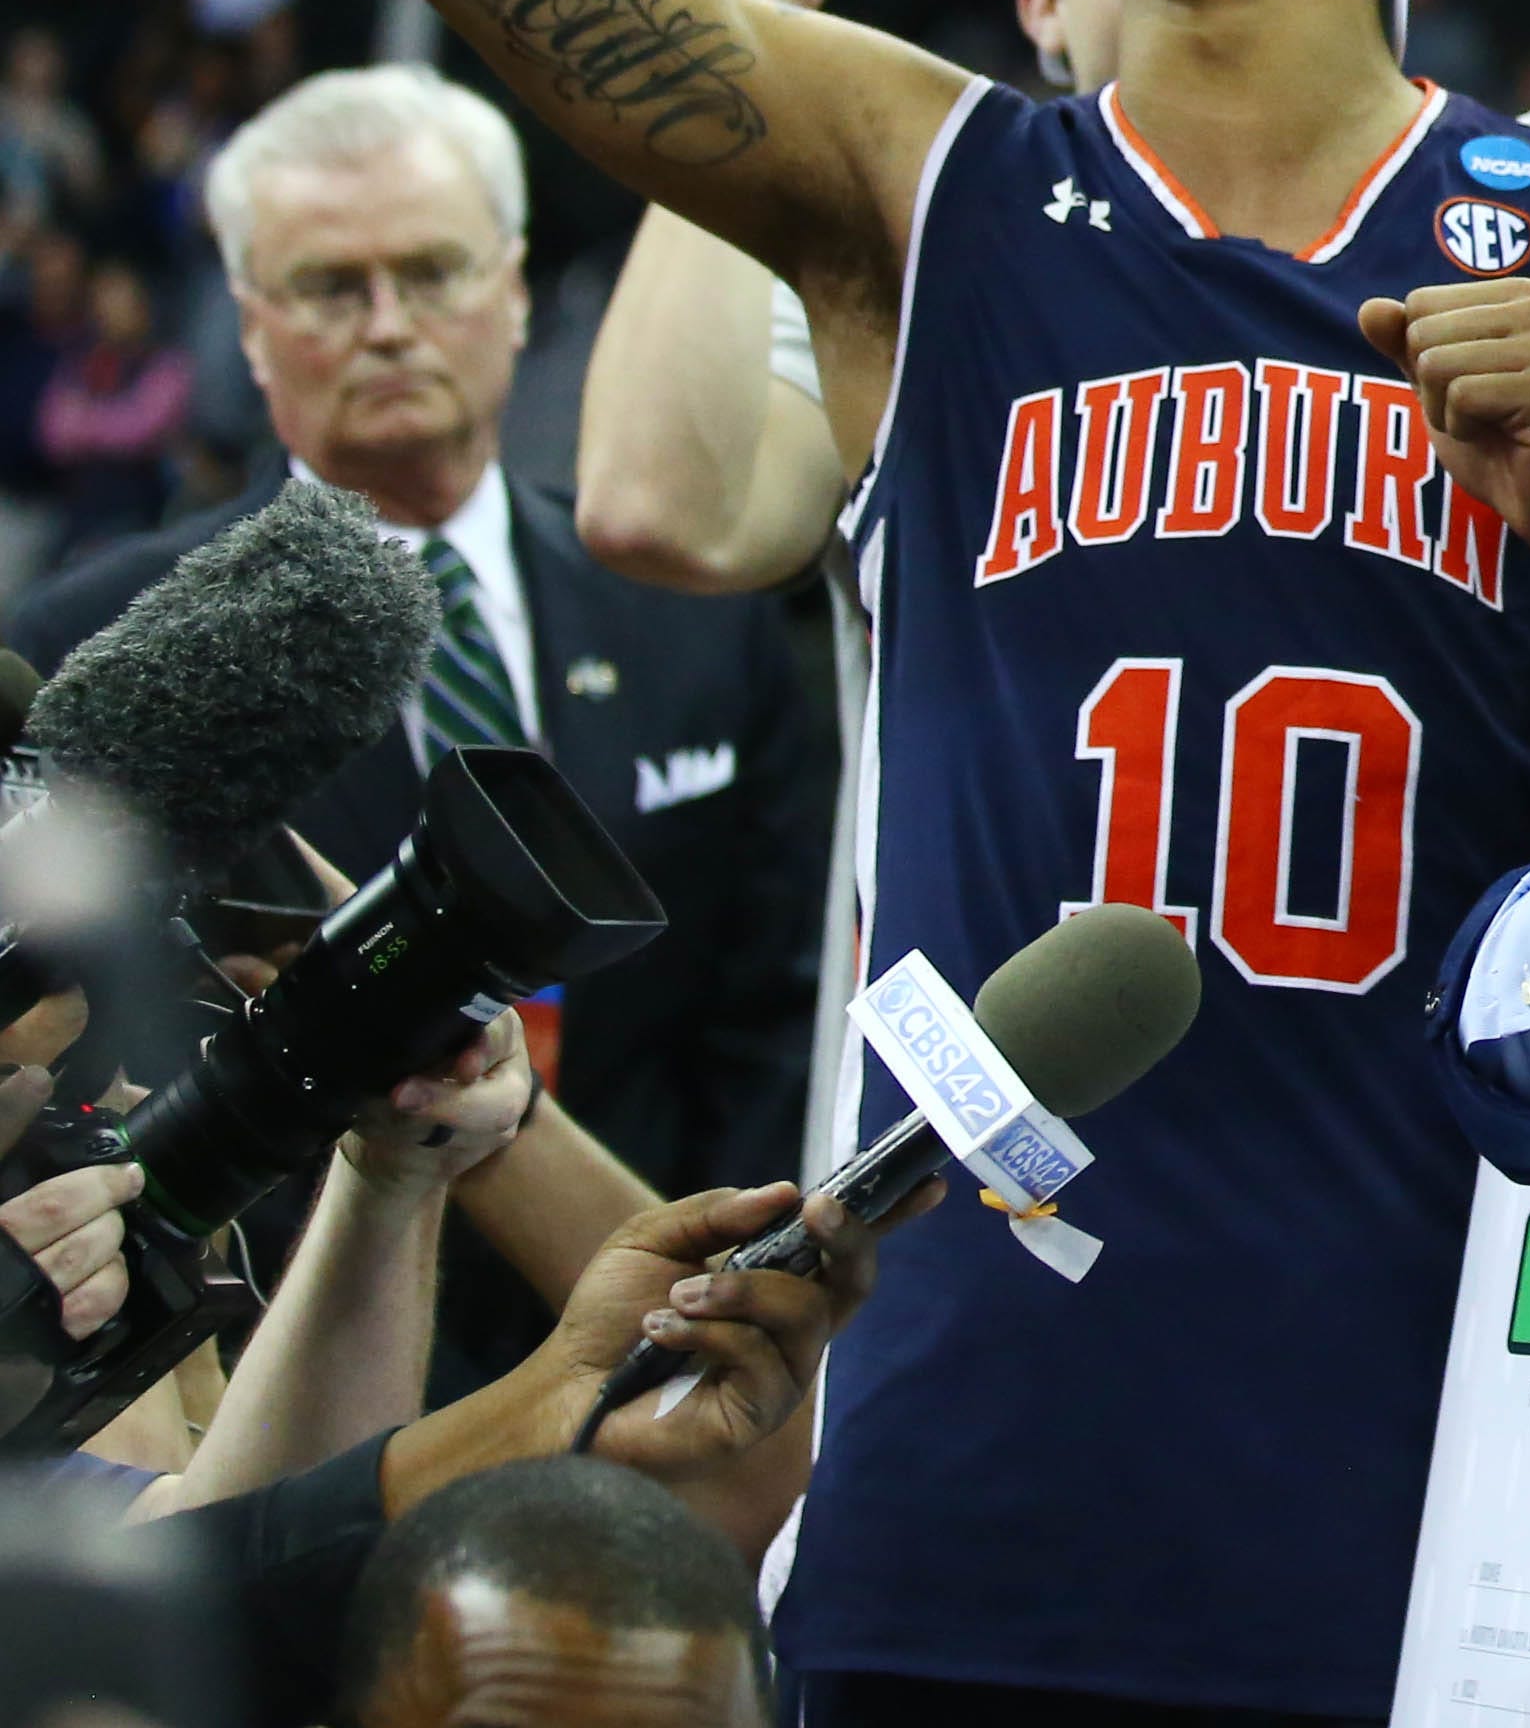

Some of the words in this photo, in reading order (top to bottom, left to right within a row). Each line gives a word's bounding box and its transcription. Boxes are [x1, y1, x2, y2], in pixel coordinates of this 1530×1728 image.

[1443, 202, 1529, 271] SEC
[974, 358, 1510, 612] AUBURN
[1059, 657, 1423, 995] 10
[358, 922, 394, 955] FUJINON
[368, 935, 408, 975] 18-55
